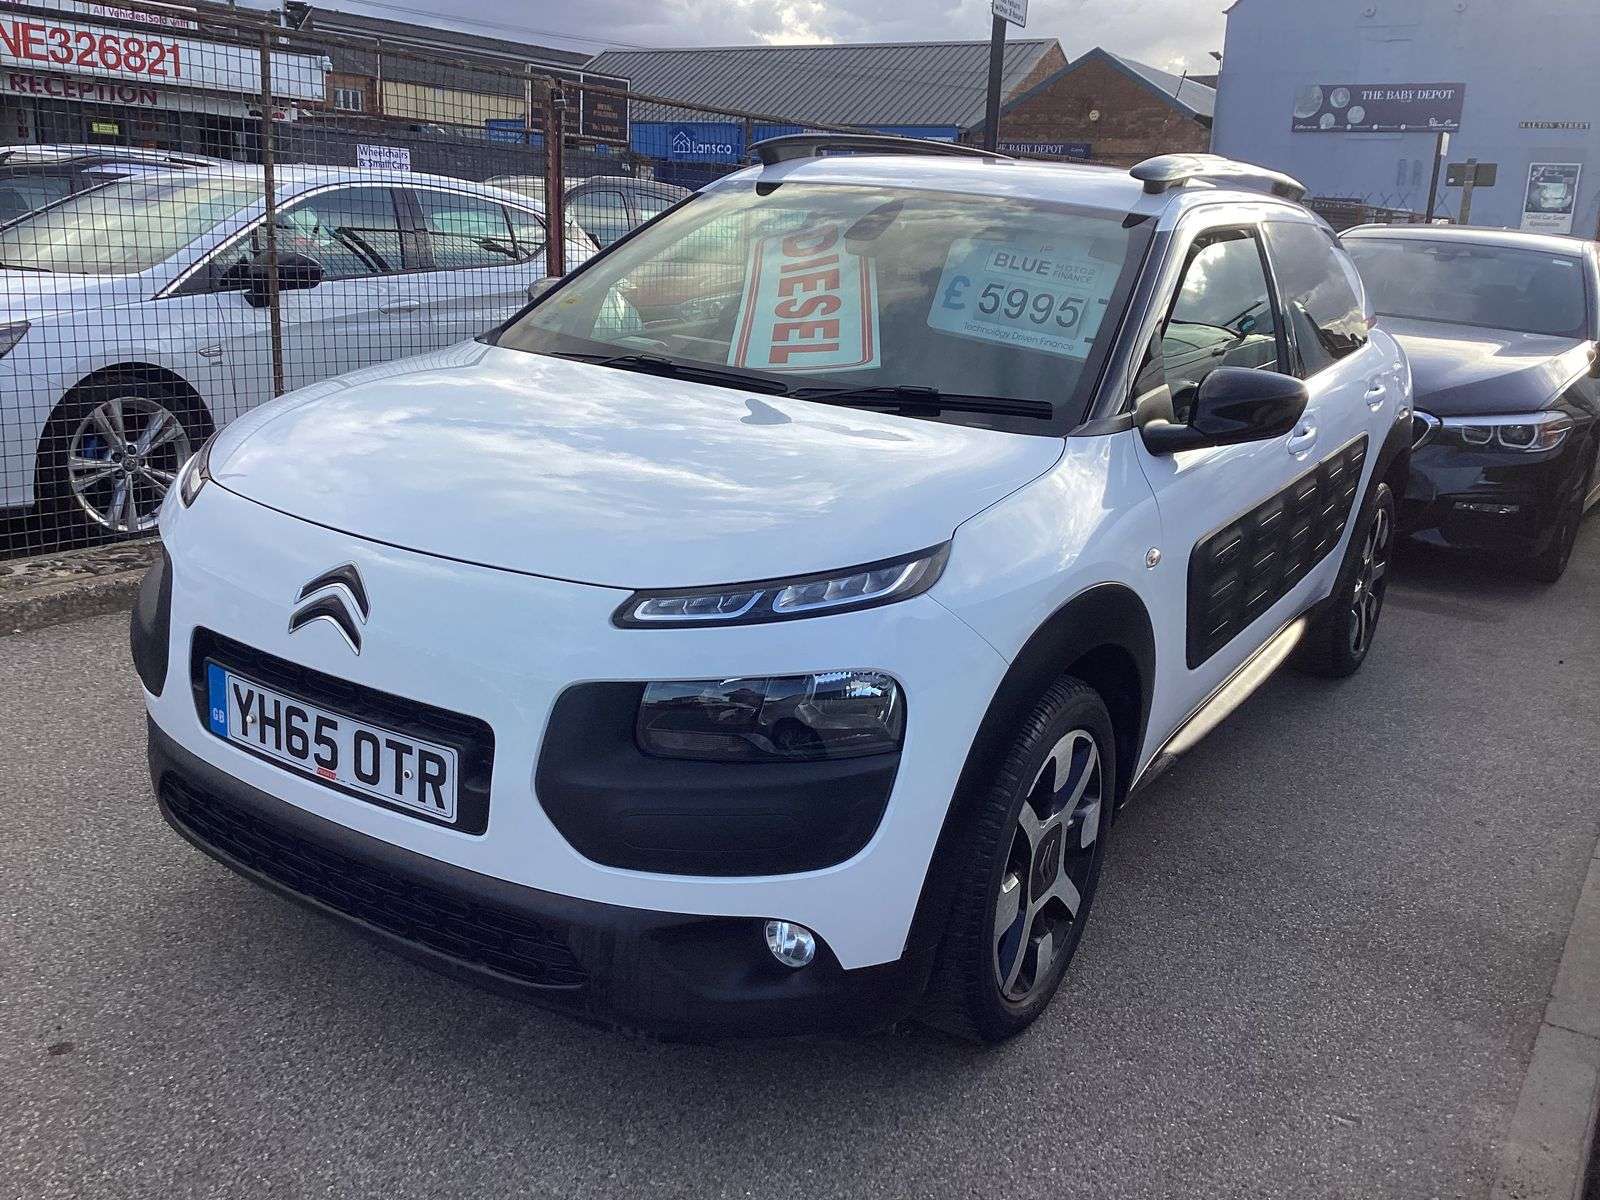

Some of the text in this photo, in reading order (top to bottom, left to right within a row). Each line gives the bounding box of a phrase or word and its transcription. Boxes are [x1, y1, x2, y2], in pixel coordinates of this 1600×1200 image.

[107, 7, 145, 21] Vehicles
[9, 73, 159, 106] RECEPTION
[1362, 89, 1455, 100] THE BABY DEPOT
[1557, 121, 1590, 129] STREET
[358, 145, 409, 160] Wheelchairs
[692, 140, 732, 154] Lansco
[1009, 143, 1032, 153] BABY
[1033, 144, 1064, 154] DEPOT
[391, 160, 409, 170] Cars
[993, 252, 1096, 276] BLUE MOTOR
[1052, 270, 1094, 284] FINANCE
[768, 223, 842, 364] DIESEL
[942, 275, 1084, 329] £ 5995
[963, 320, 1074, 351] Technology Driven Finance
[212, 706, 225, 724] GB
[232, 683, 446, 809] YH65 OTR
